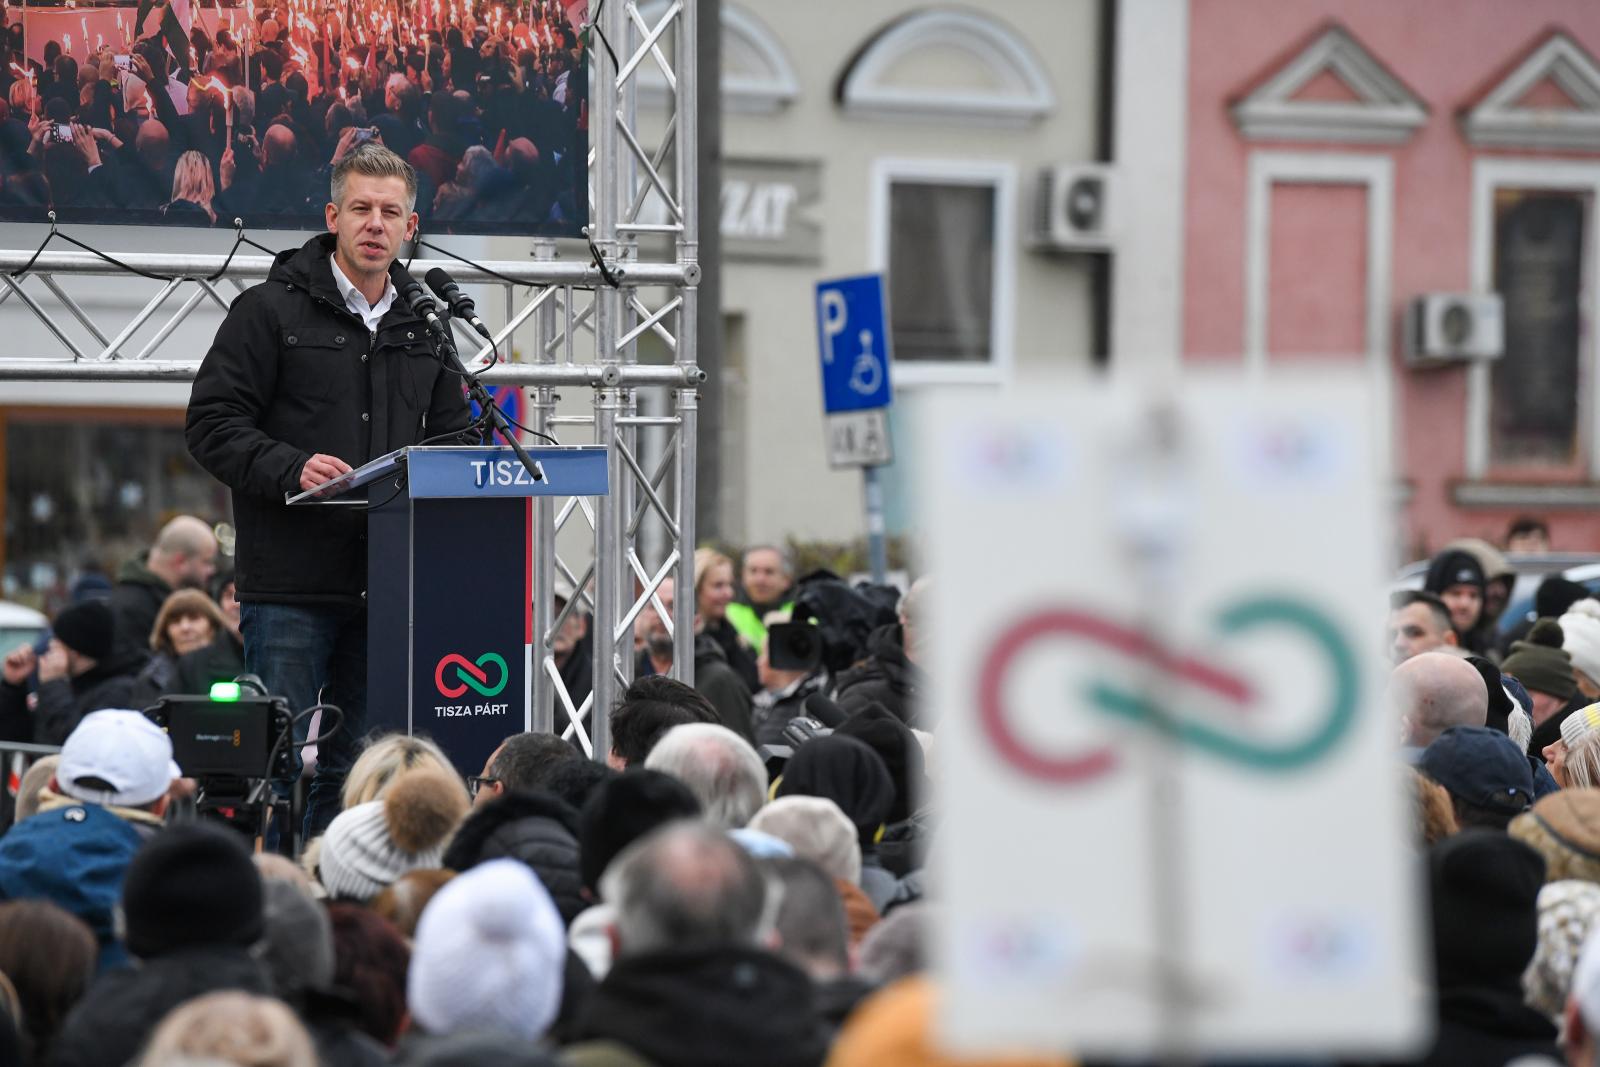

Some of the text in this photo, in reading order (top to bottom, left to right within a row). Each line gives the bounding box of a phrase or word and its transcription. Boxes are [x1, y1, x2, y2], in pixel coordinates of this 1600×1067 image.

[720, 181, 798, 240] ZAT
[821, 289, 847, 364] P
[471, 460, 549, 486] TISZA
[434, 702, 509, 717] TISZA PÁRT
